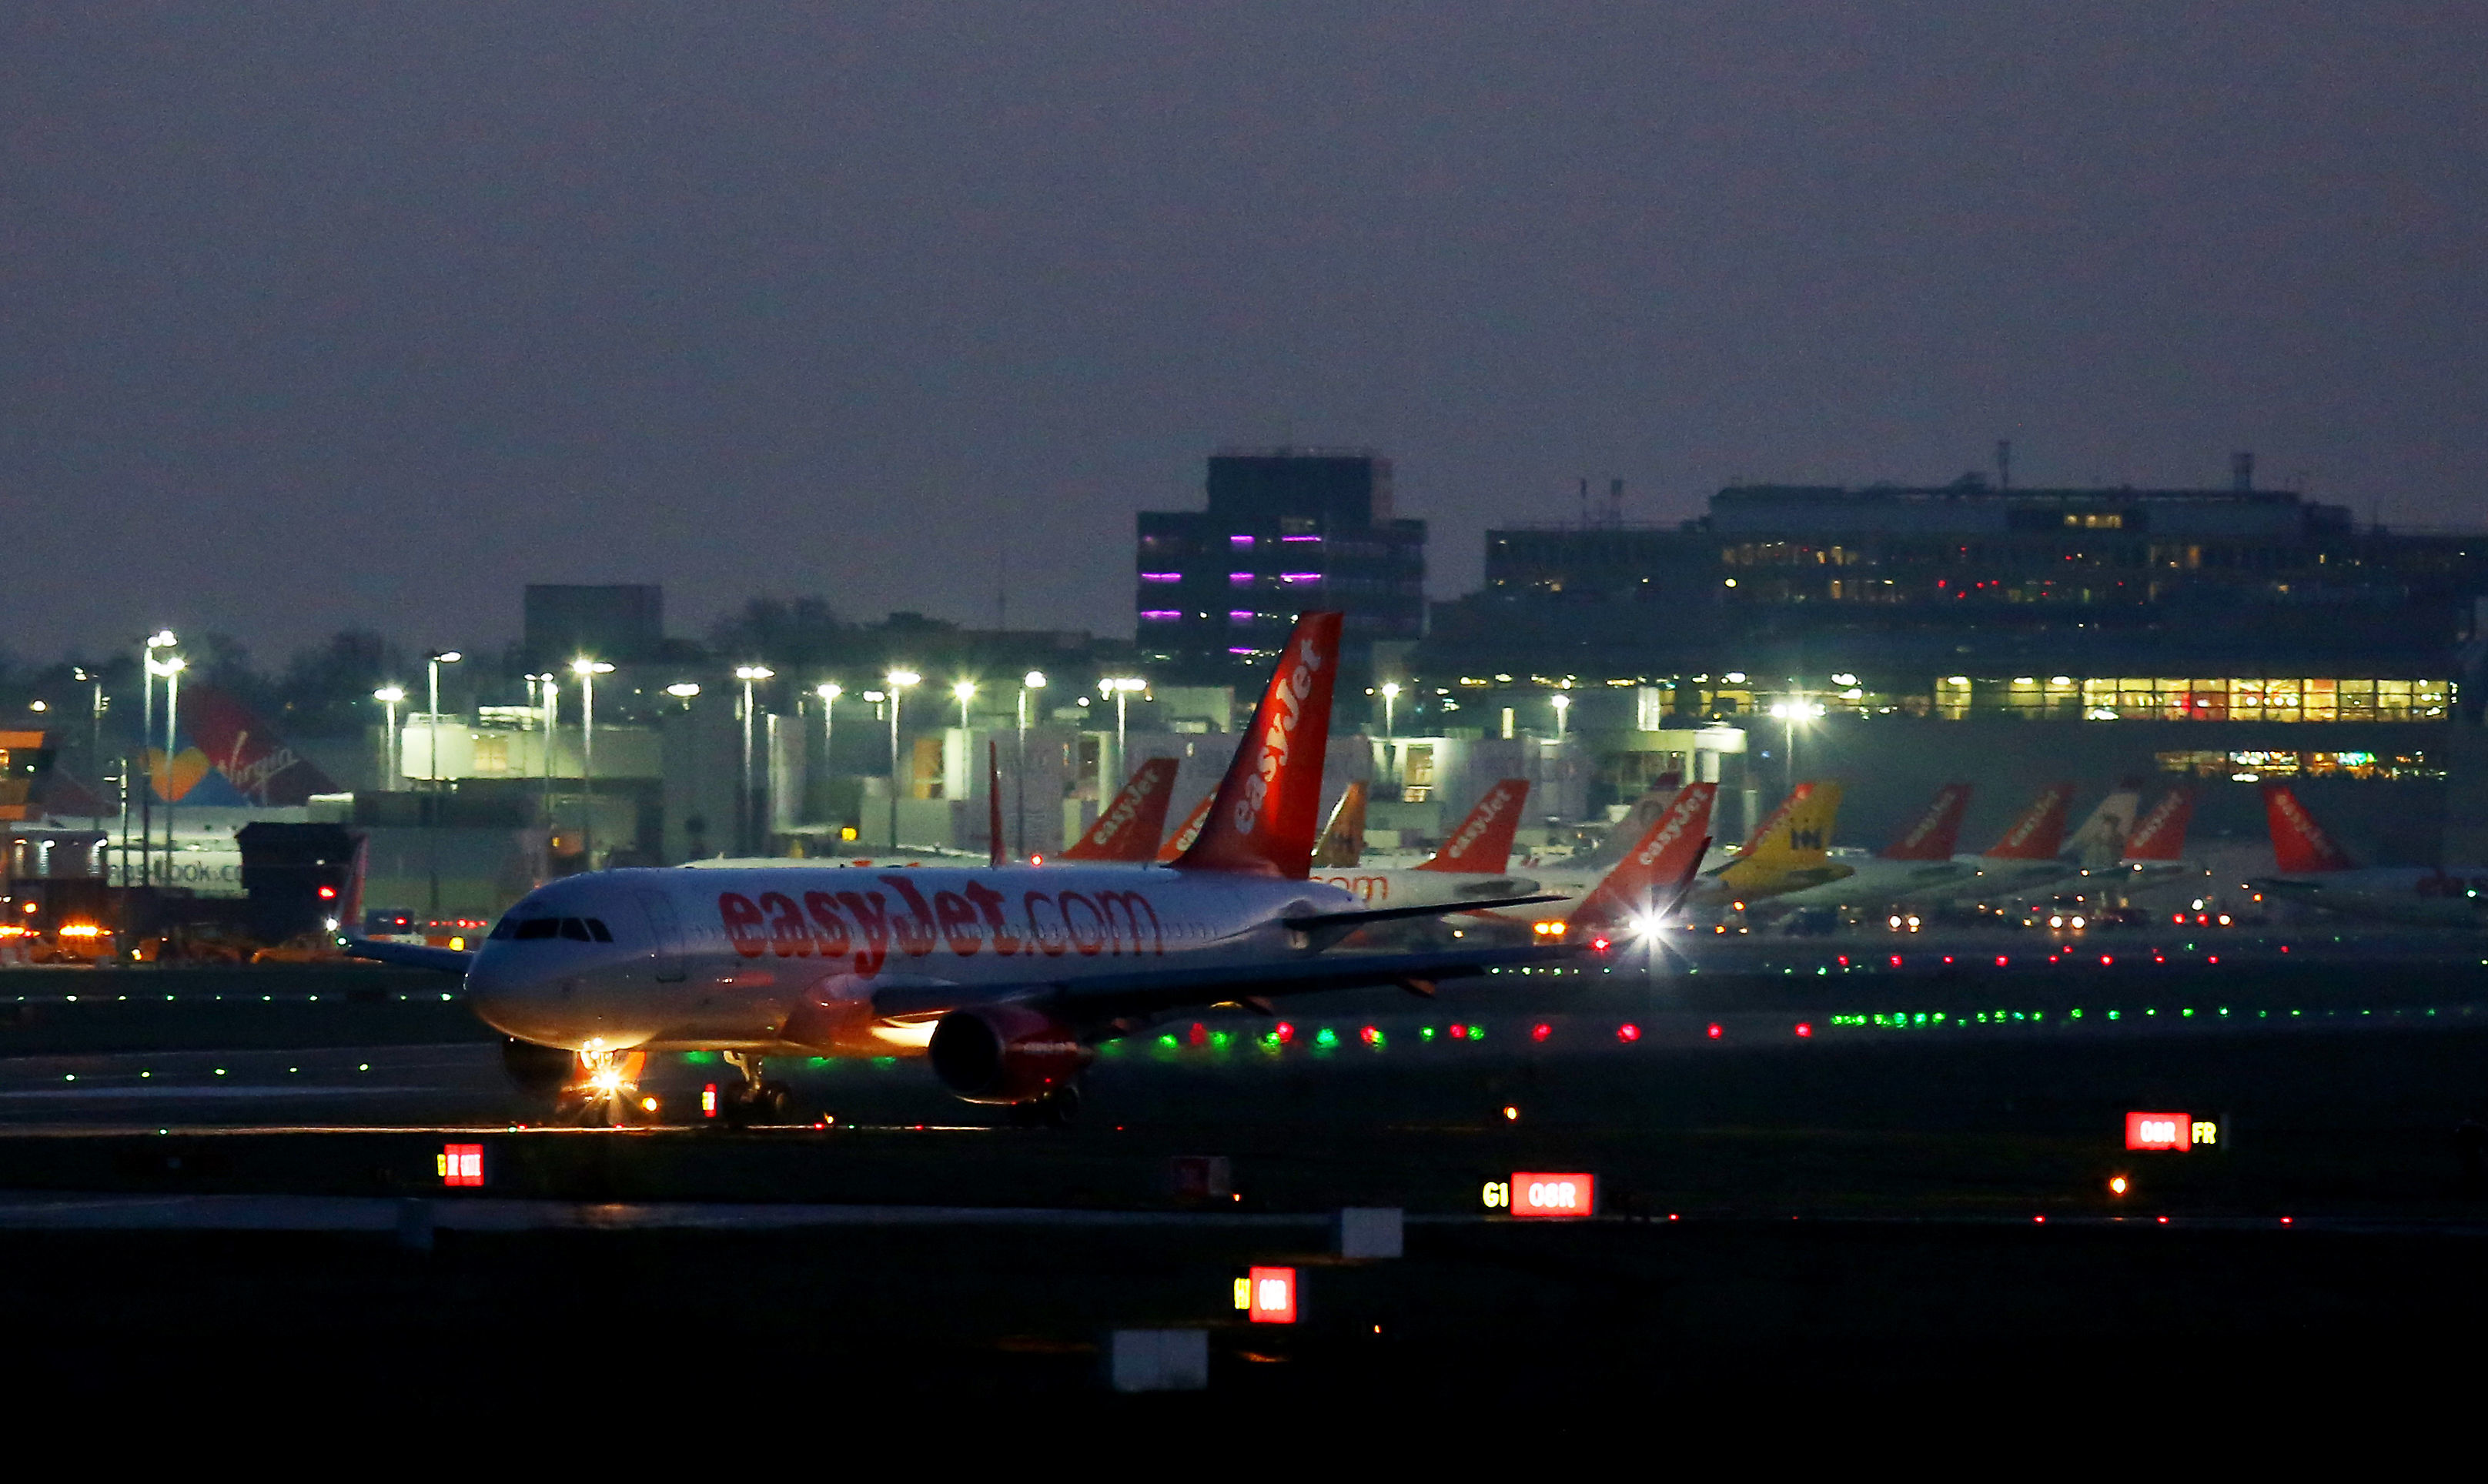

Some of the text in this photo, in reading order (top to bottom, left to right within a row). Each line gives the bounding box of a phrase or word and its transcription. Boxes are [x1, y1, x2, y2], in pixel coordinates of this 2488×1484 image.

[216, 730, 299, 805] Virgin
[1235, 640, 1321, 834] easyJet
[1092, 768, 1159, 846] easyJet
[1448, 789, 1512, 859] easyJet
[1639, 789, 1708, 865] easyJet
[717, 875, 1163, 978] easyJet.com
[2192, 1121, 2217, 1144] FR
[1483, 1182, 1576, 1208] G1 08R
